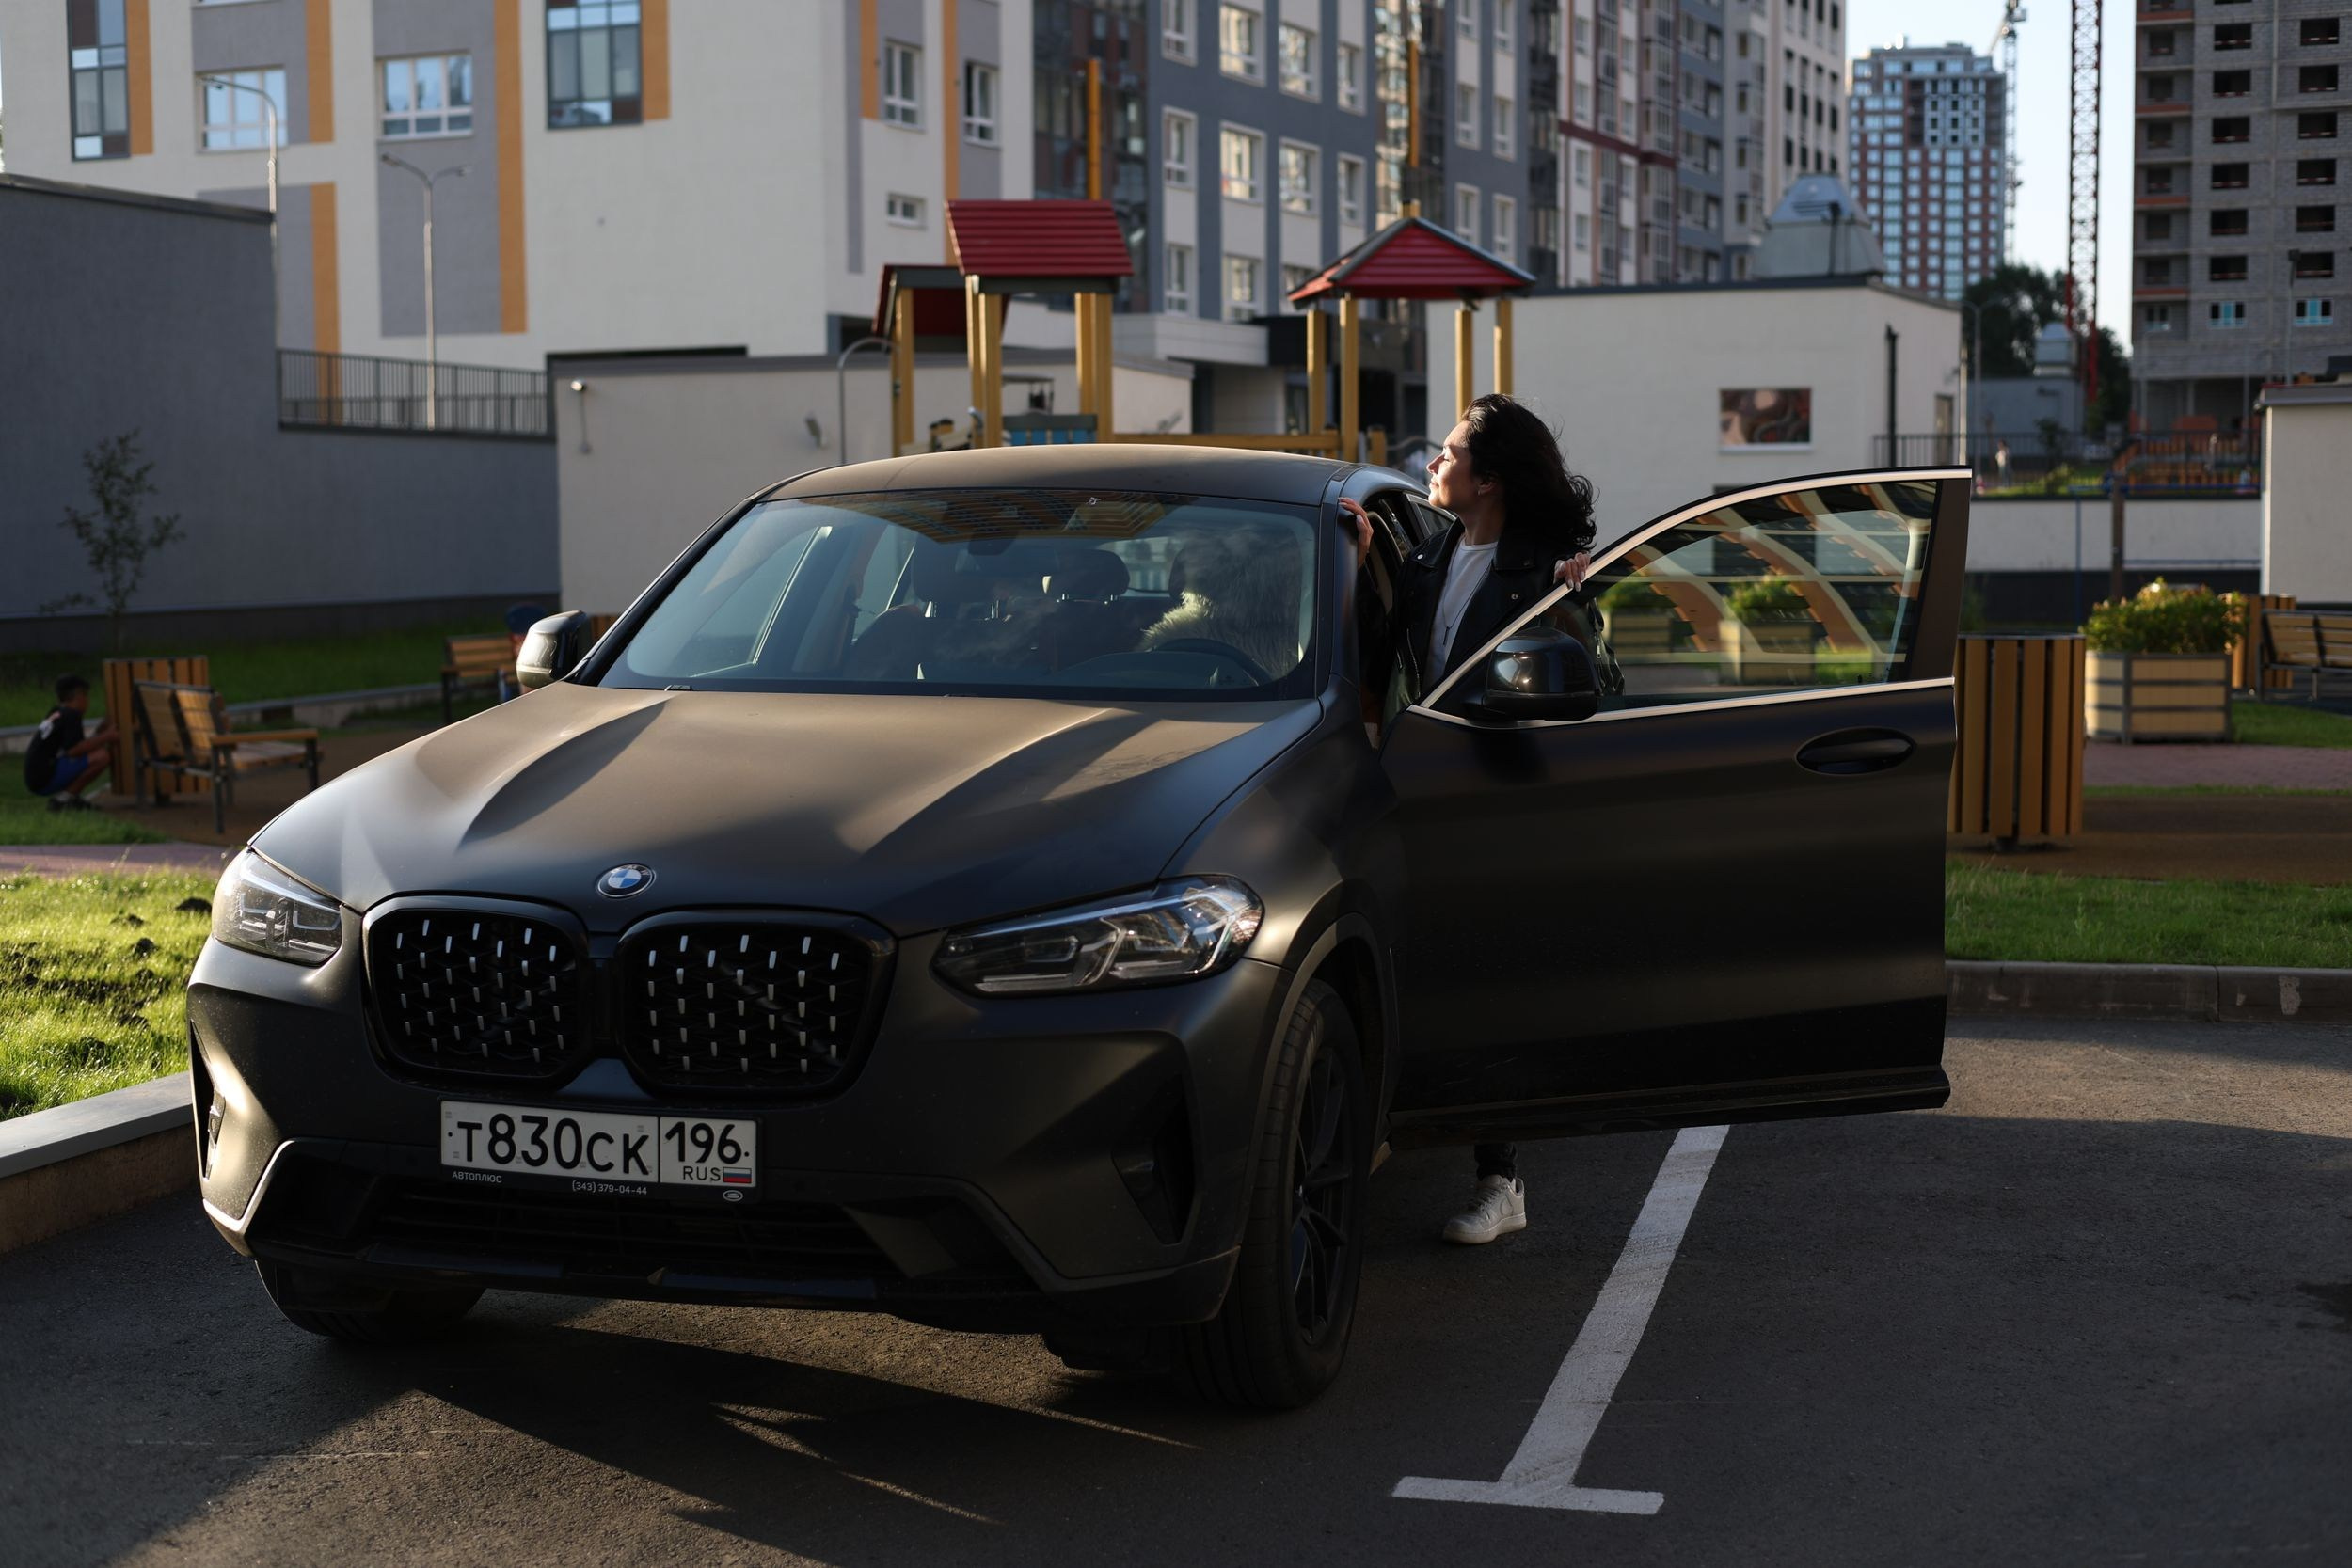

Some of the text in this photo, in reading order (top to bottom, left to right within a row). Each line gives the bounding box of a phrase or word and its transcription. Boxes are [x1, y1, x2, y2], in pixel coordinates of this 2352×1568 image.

[664, 1121, 742, 1164] 196
[452, 1170, 502, 1183] АВТОПЛЮС
[682, 1165, 722, 1181] RUS
[572, 1180, 648, 1196] (343) 379-04-44
